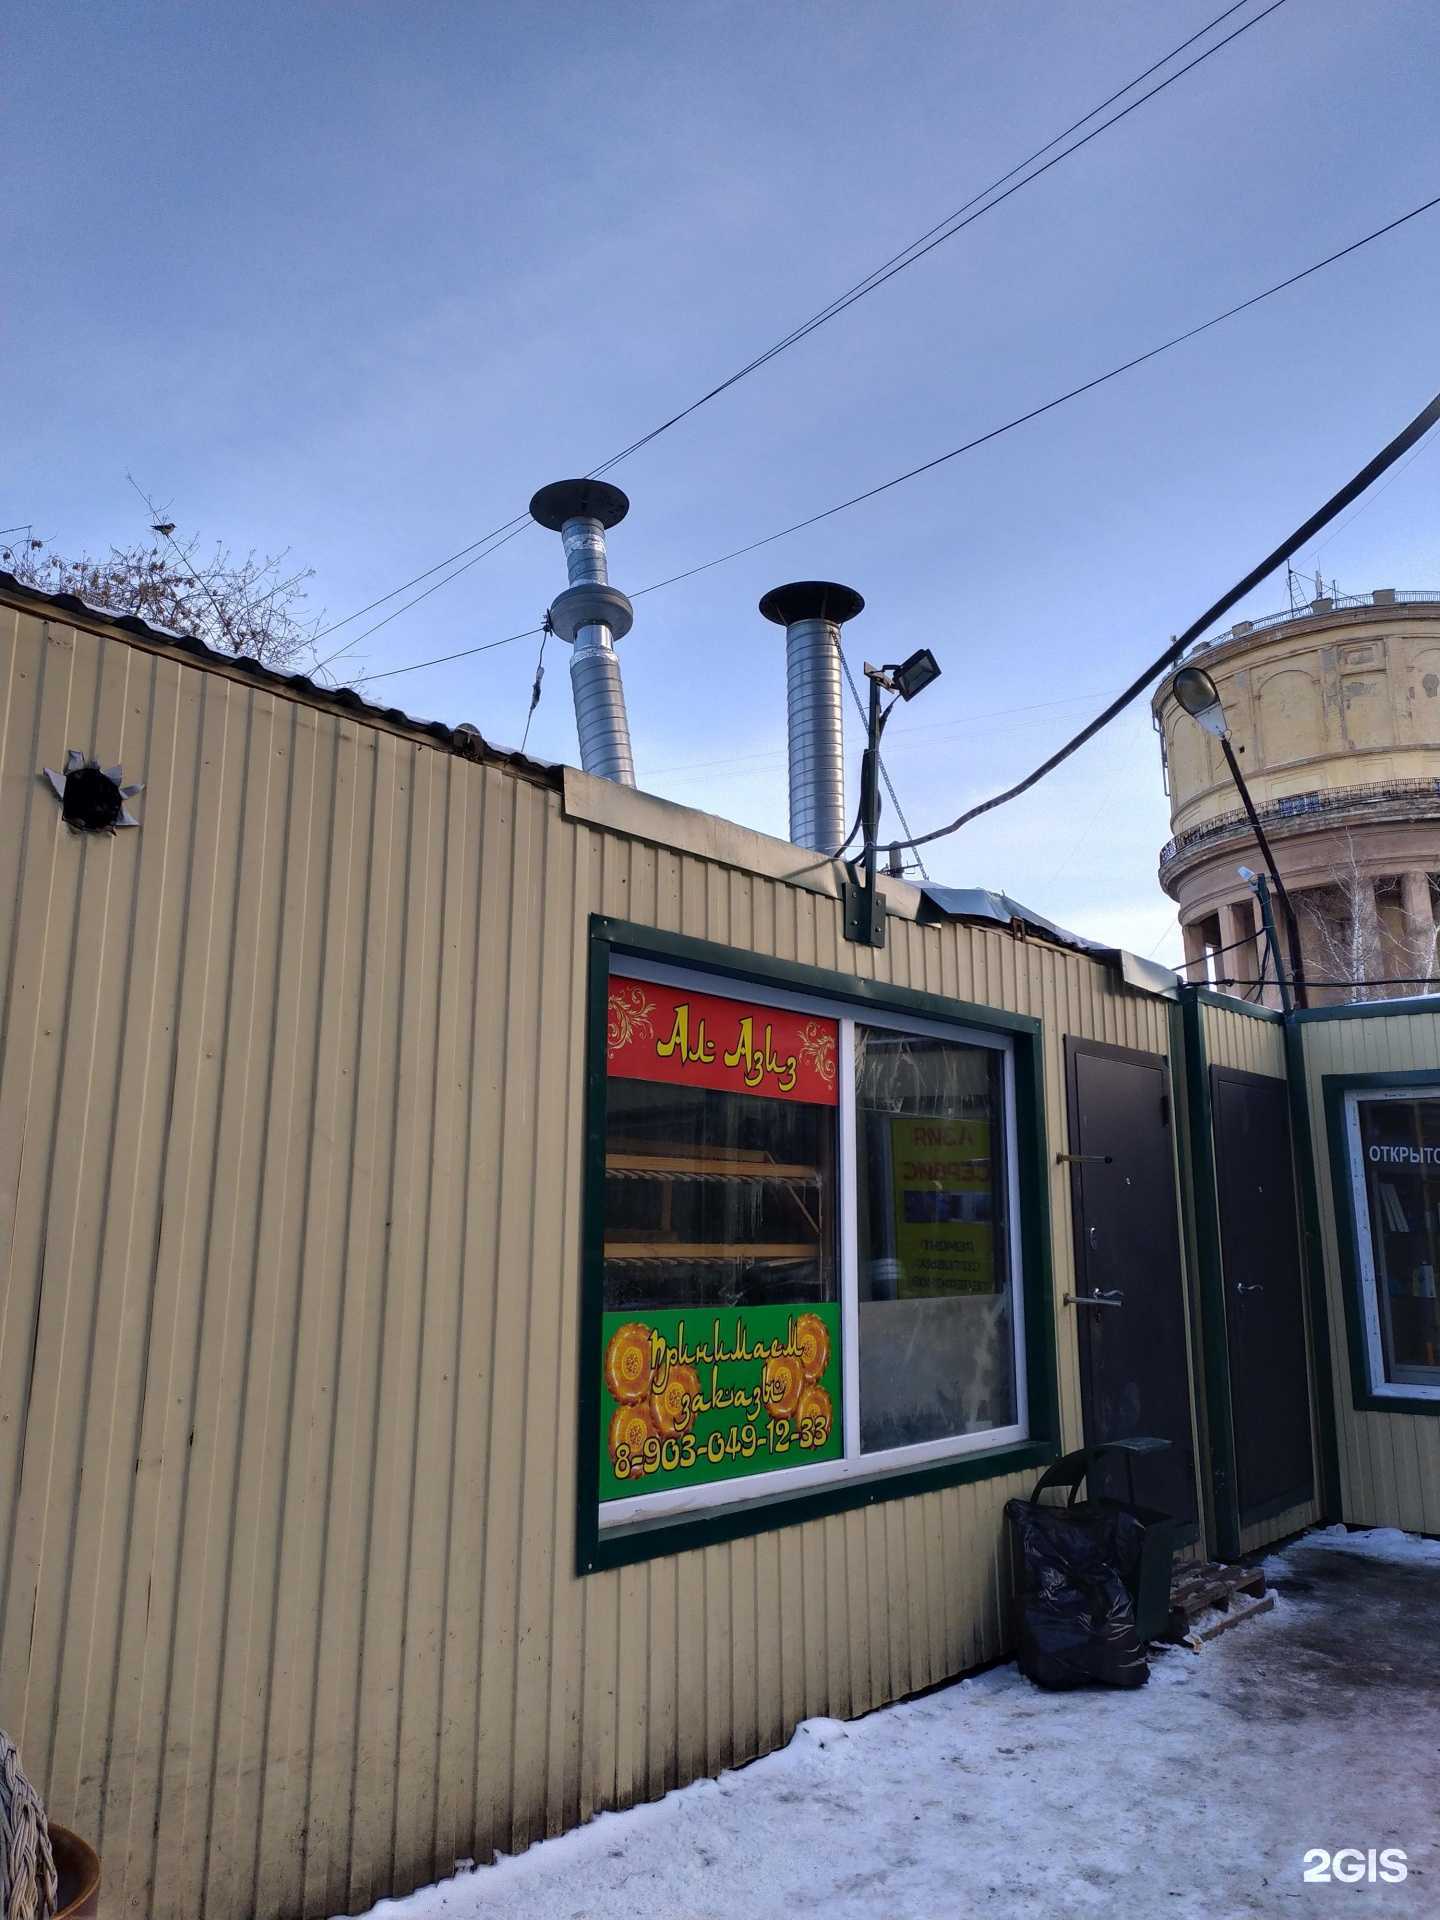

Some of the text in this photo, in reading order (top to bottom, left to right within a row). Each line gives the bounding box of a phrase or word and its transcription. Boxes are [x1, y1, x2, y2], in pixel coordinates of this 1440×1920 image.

[648, 1314, 806, 1394] Принимаем
[673, 1362, 787, 1432] заказы
[614, 1416, 828, 1479] 8-903-049-12-33
